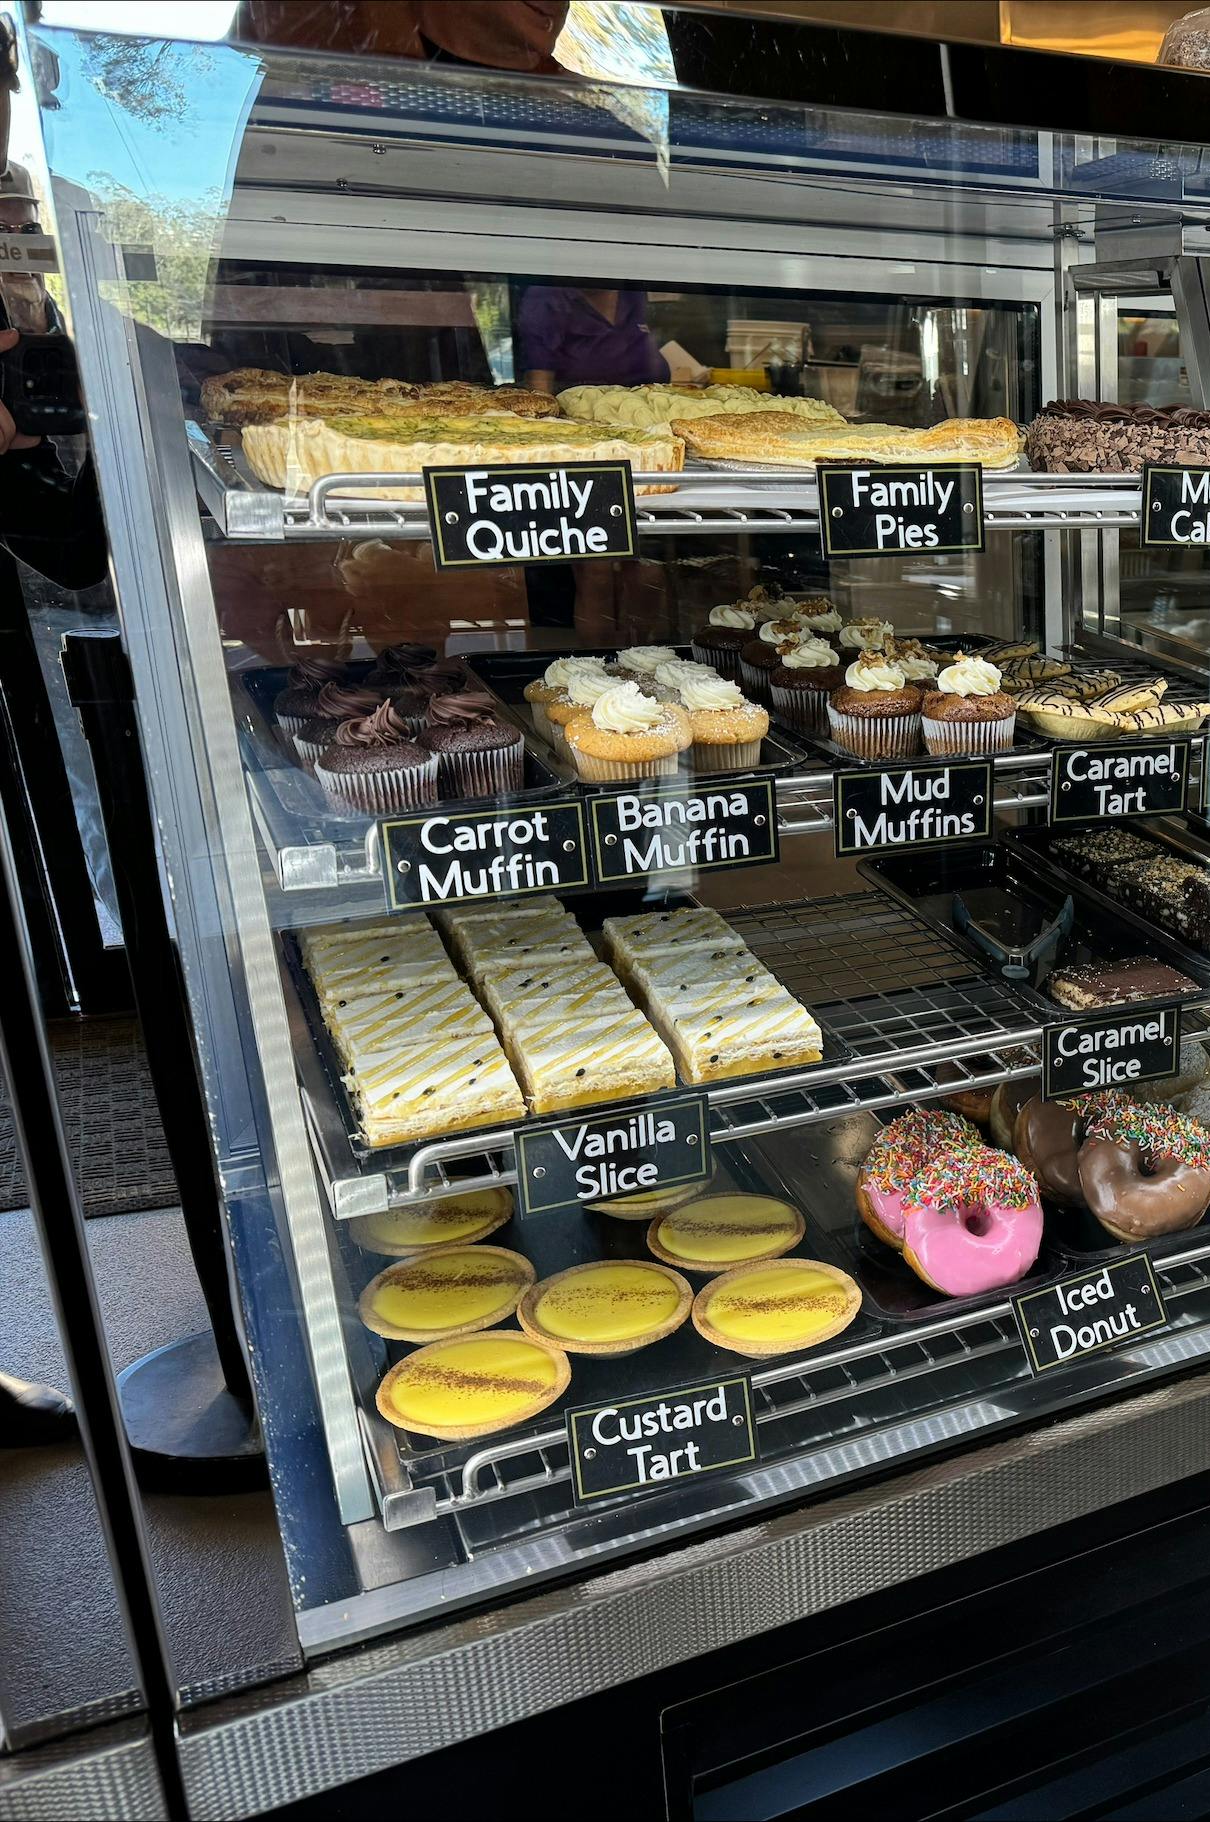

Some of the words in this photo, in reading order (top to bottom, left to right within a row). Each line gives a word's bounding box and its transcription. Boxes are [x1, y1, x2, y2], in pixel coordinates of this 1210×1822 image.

[464, 469, 594, 519] Family
[851, 470, 955, 515] Family
[465, 516, 609, 561] Quiche
[875, 514, 940, 550] Pies
[1066, 744, 1176, 782] Caramel
[880, 768, 951, 806] Mud
[1093, 784, 1147, 816] Tart
[420, 811, 550, 855] Carrot
[616, 792, 749, 832] Banana
[854, 807, 976, 848] Muffins
[623, 827, 750, 874] Muffin
[418, 853, 560, 902] Muffin
[1057, 1011, 1165, 1057] Caramel
[1082, 1057, 1142, 1087] Slice
[552, 1113, 676, 1162] Vanilla
[575, 1162, 659, 1200] Slice
[1055, 1268, 1115, 1316] Iced
[1050, 1303, 1142, 1360] Donut
[592, 1386, 728, 1446] Custard
[627, 1441, 702, 1483] Tart
